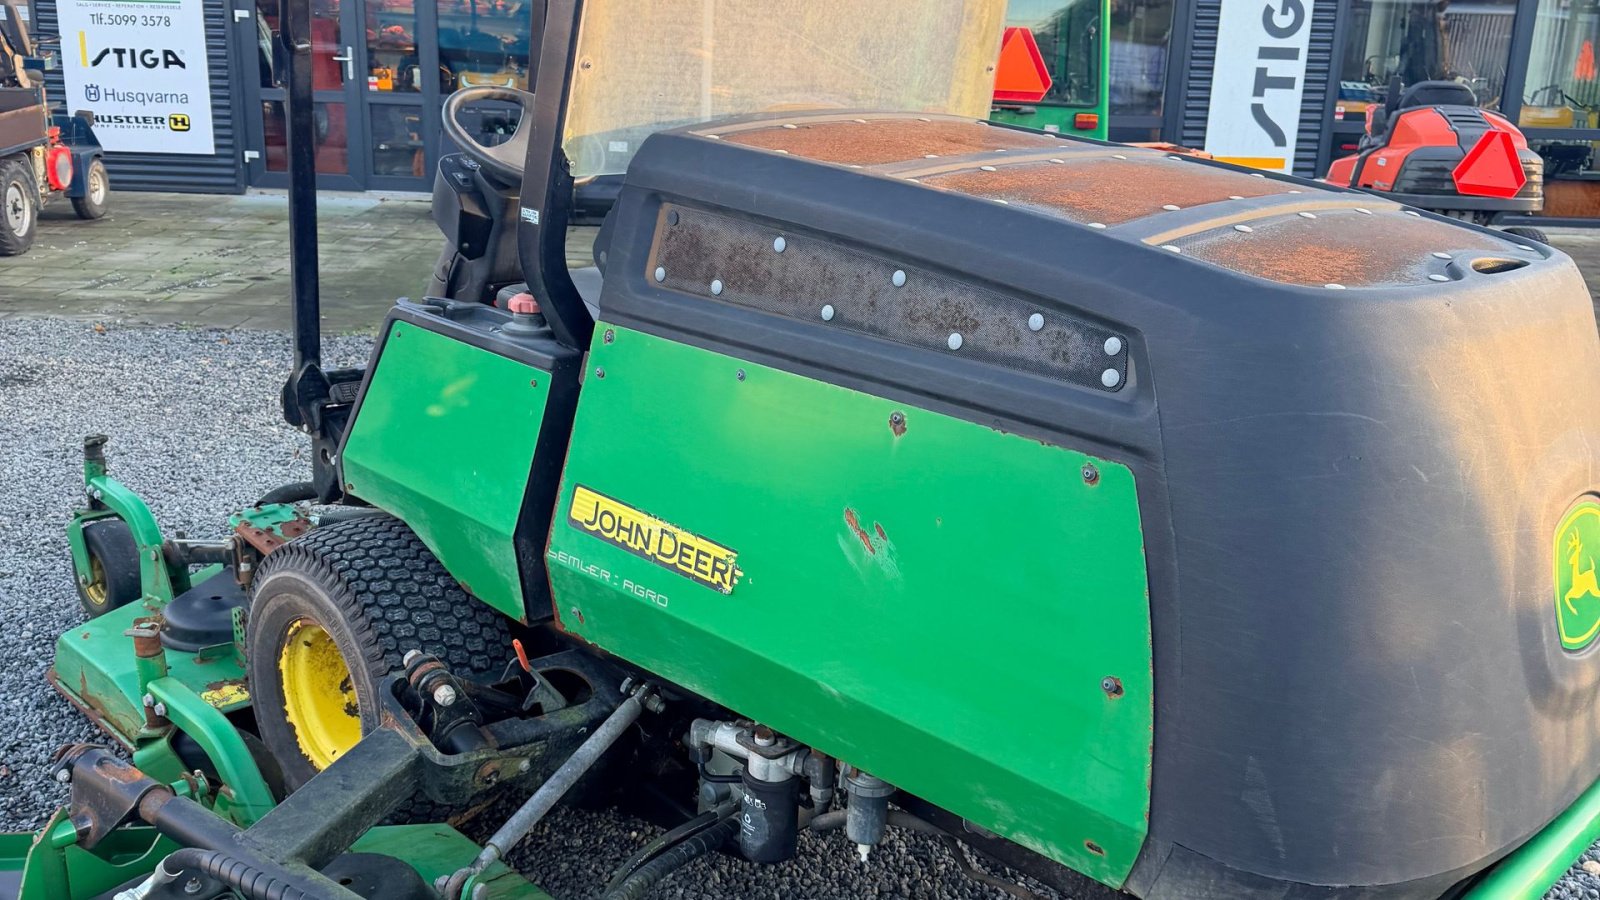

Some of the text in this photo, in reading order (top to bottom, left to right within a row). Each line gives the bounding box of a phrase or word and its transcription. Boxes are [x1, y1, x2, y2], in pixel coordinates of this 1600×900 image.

[141, 15, 171, 27] 3578
[91, 47, 186, 69] STIGA
[1250, 0, 1305, 147] STIG
[103, 87, 189, 106] Husqvarna
[584, 501, 652, 551] JOHN
[622, 580, 669, 608] AGRO
